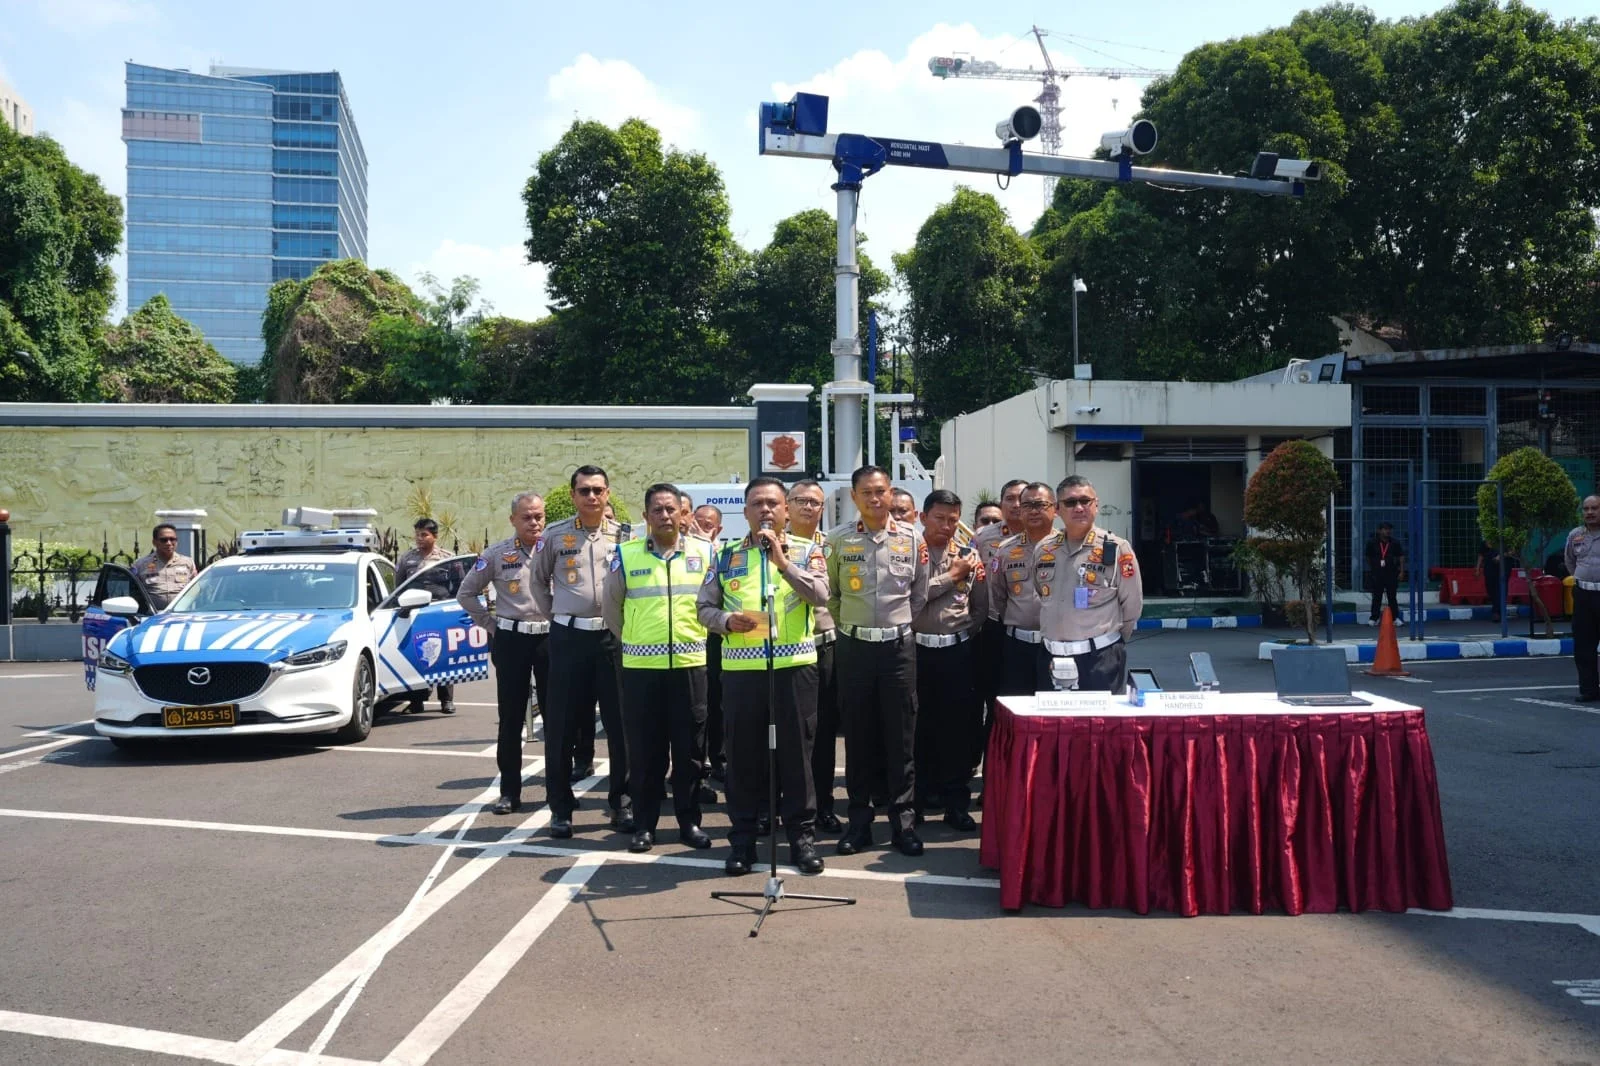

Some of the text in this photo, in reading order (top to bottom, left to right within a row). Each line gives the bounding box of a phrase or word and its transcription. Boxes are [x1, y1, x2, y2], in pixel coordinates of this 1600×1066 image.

[843, 554, 866, 562] FAIZAL
[237, 564, 326, 572] KORLANTAS
[1081, 563, 1106, 573] POLRI
[160, 612, 320, 625] POLISI
[448, 653, 488, 665] LALU
[186, 710, 231, 722] 2435-15
